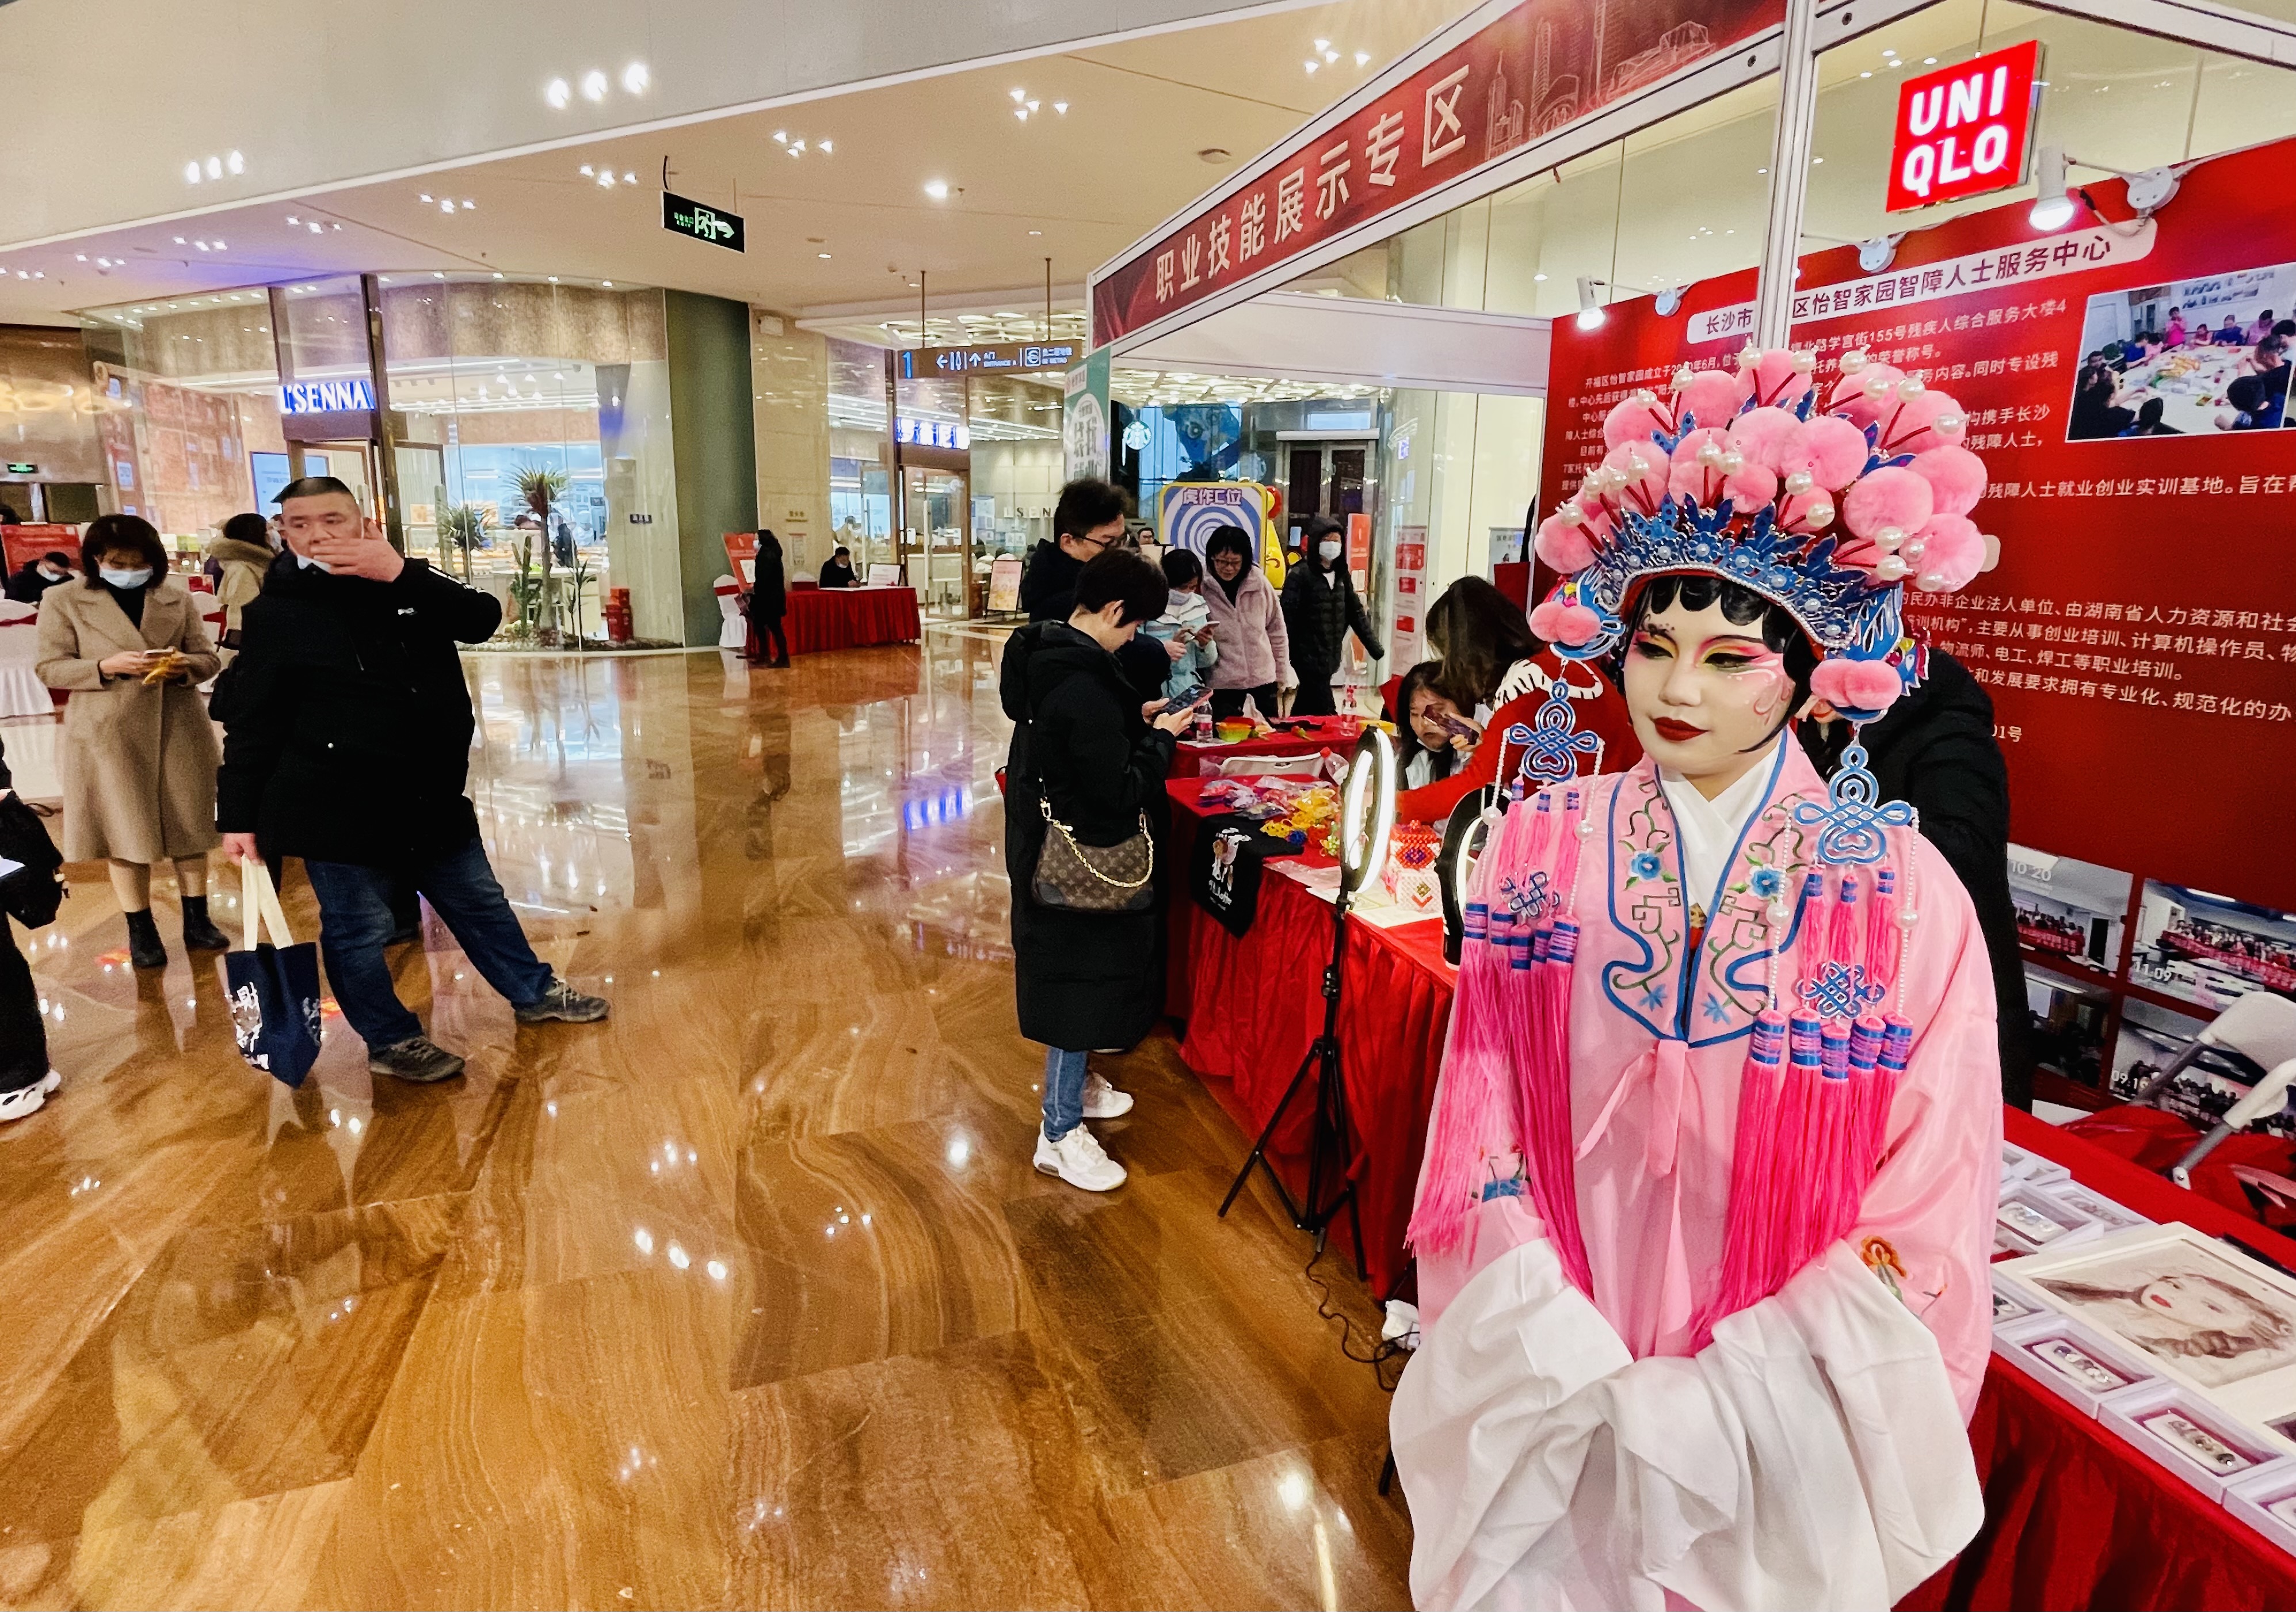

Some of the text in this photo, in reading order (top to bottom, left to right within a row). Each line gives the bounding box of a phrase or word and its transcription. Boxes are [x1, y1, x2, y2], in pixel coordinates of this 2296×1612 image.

[1909, 66, 2008, 136] UNI
[1155, 63, 1470, 304] 职业技能展示专区
[1902, 124, 2009, 197] QLO
[1706, 235, 2111, 335] 长沙市区怡智家园智障人士服务中心
[278, 380, 371, 415] L'SENNA
[902, 352, 913, 378] 1
